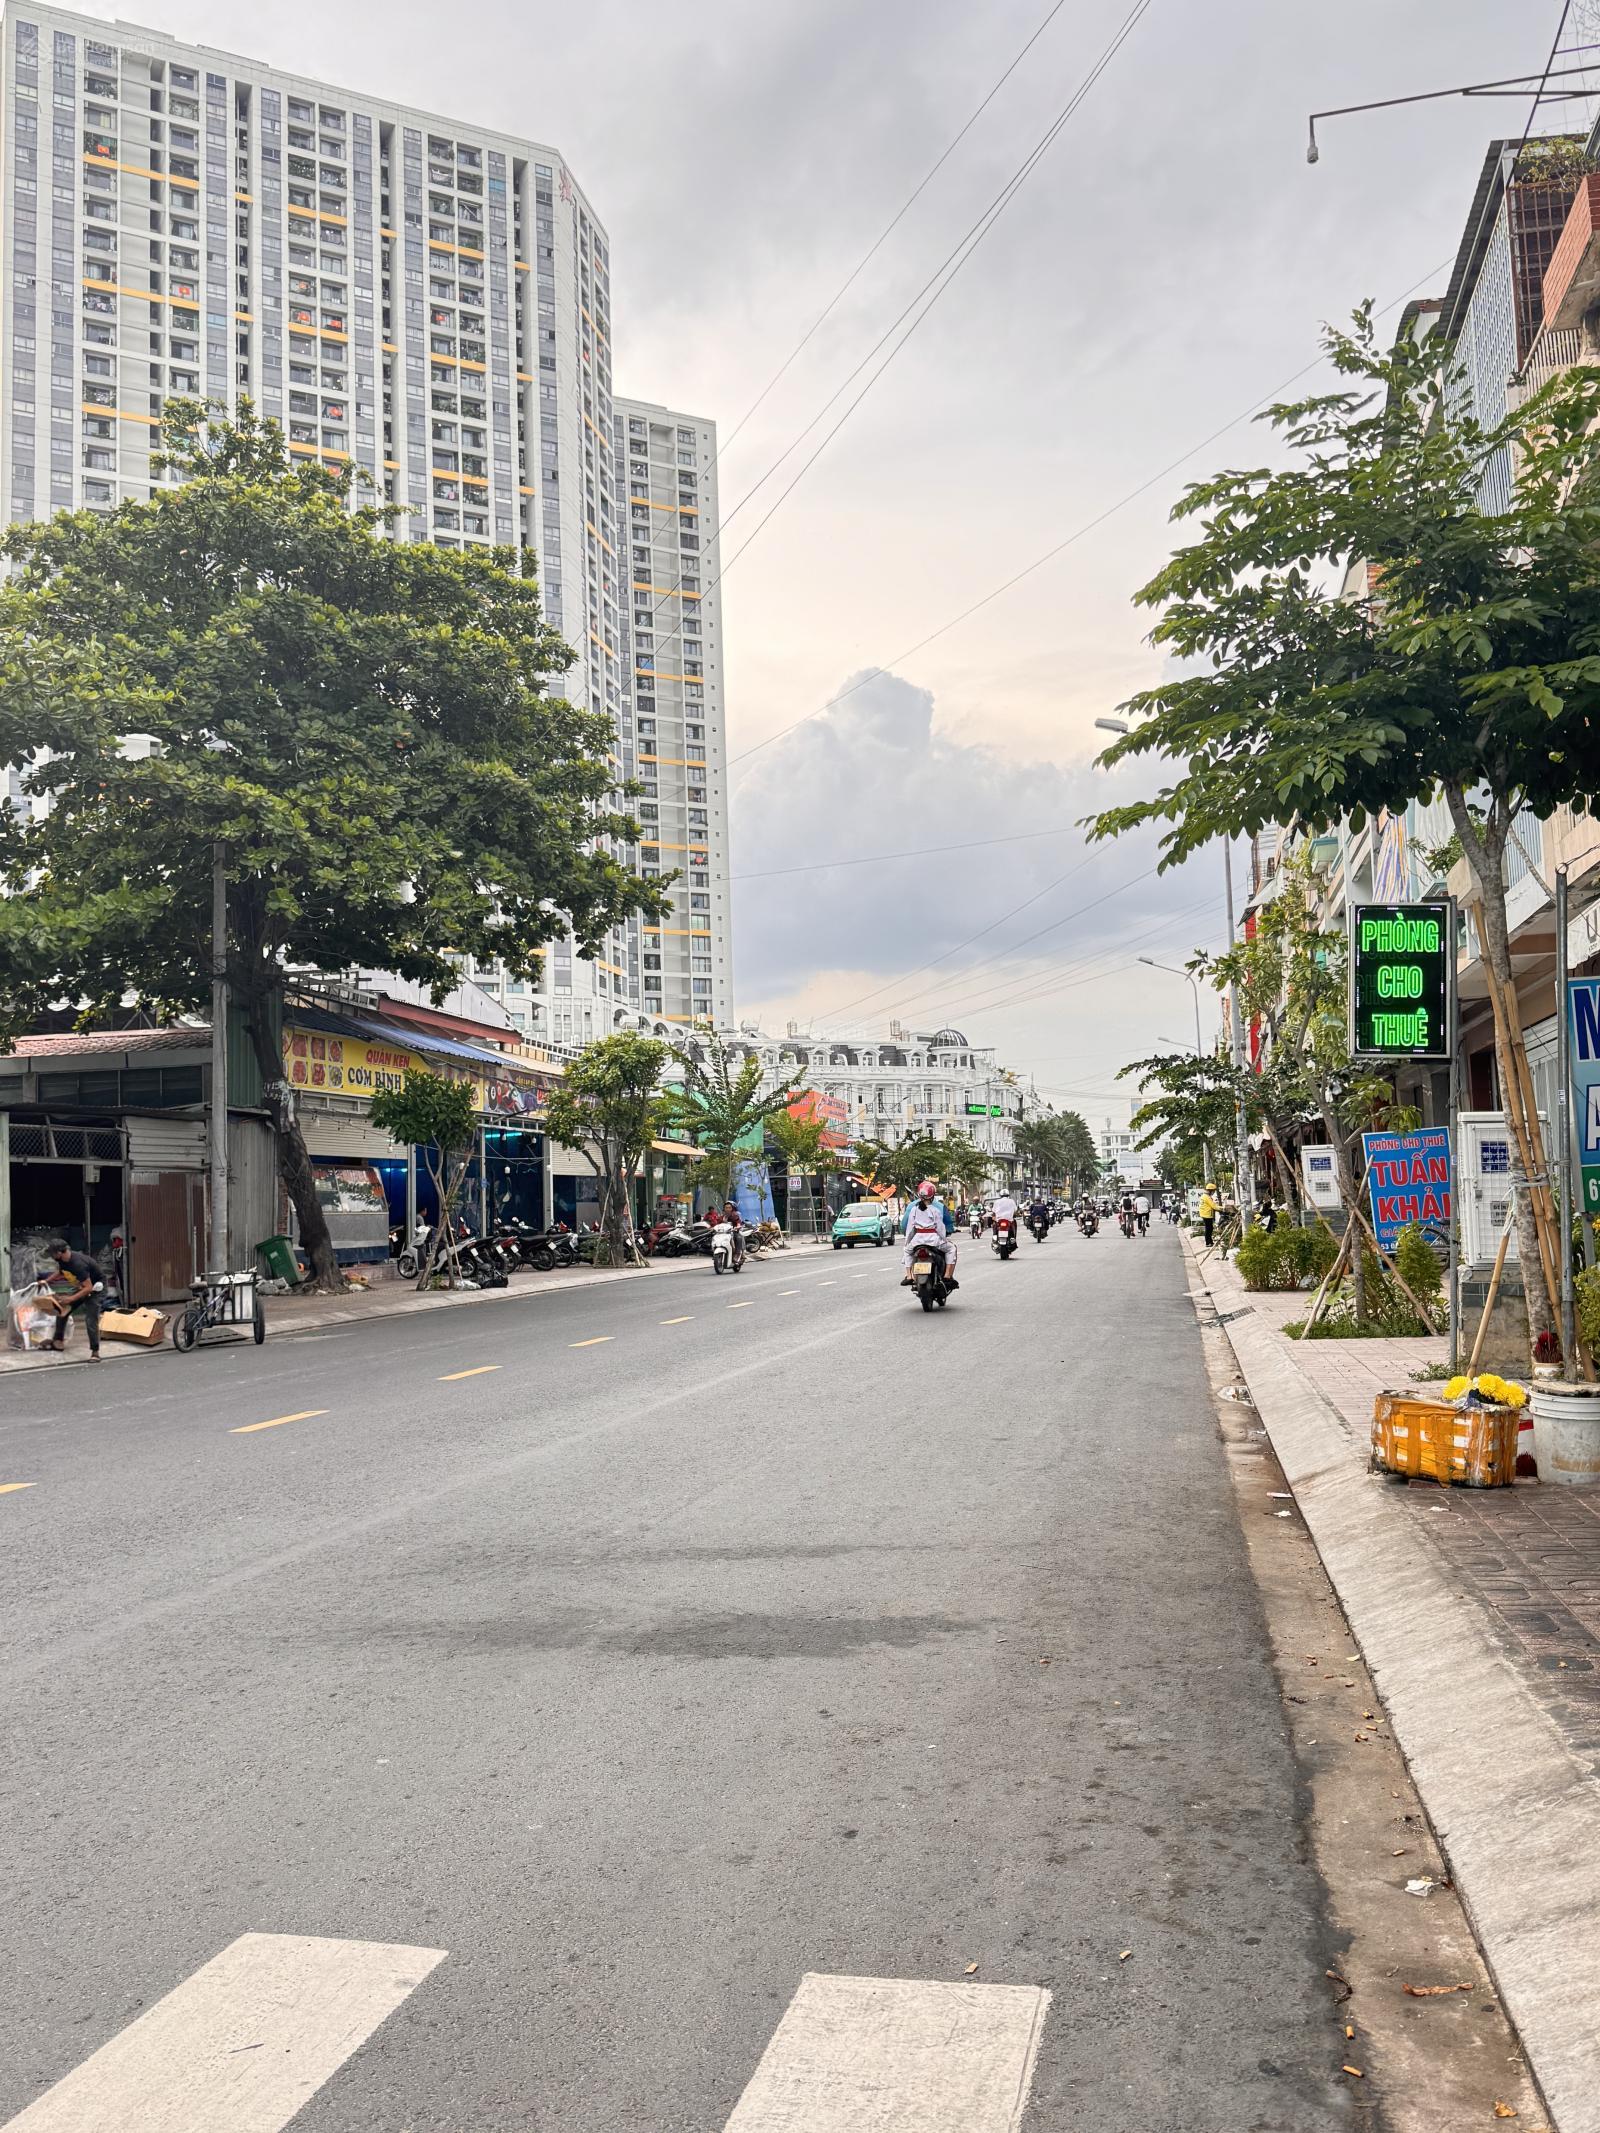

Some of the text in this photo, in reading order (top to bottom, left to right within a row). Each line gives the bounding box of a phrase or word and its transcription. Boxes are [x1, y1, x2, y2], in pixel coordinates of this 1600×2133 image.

[1361, 912, 1439, 953] PHÒNG
[1377, 965, 1423, 998] CHO
[1371, 1007, 1429, 1047] THUÊ
[347, 1066, 372, 1087] CƠM
[393, 1055, 411, 1069] KEN
[1371, 1148, 1449, 1188] TUẤN
